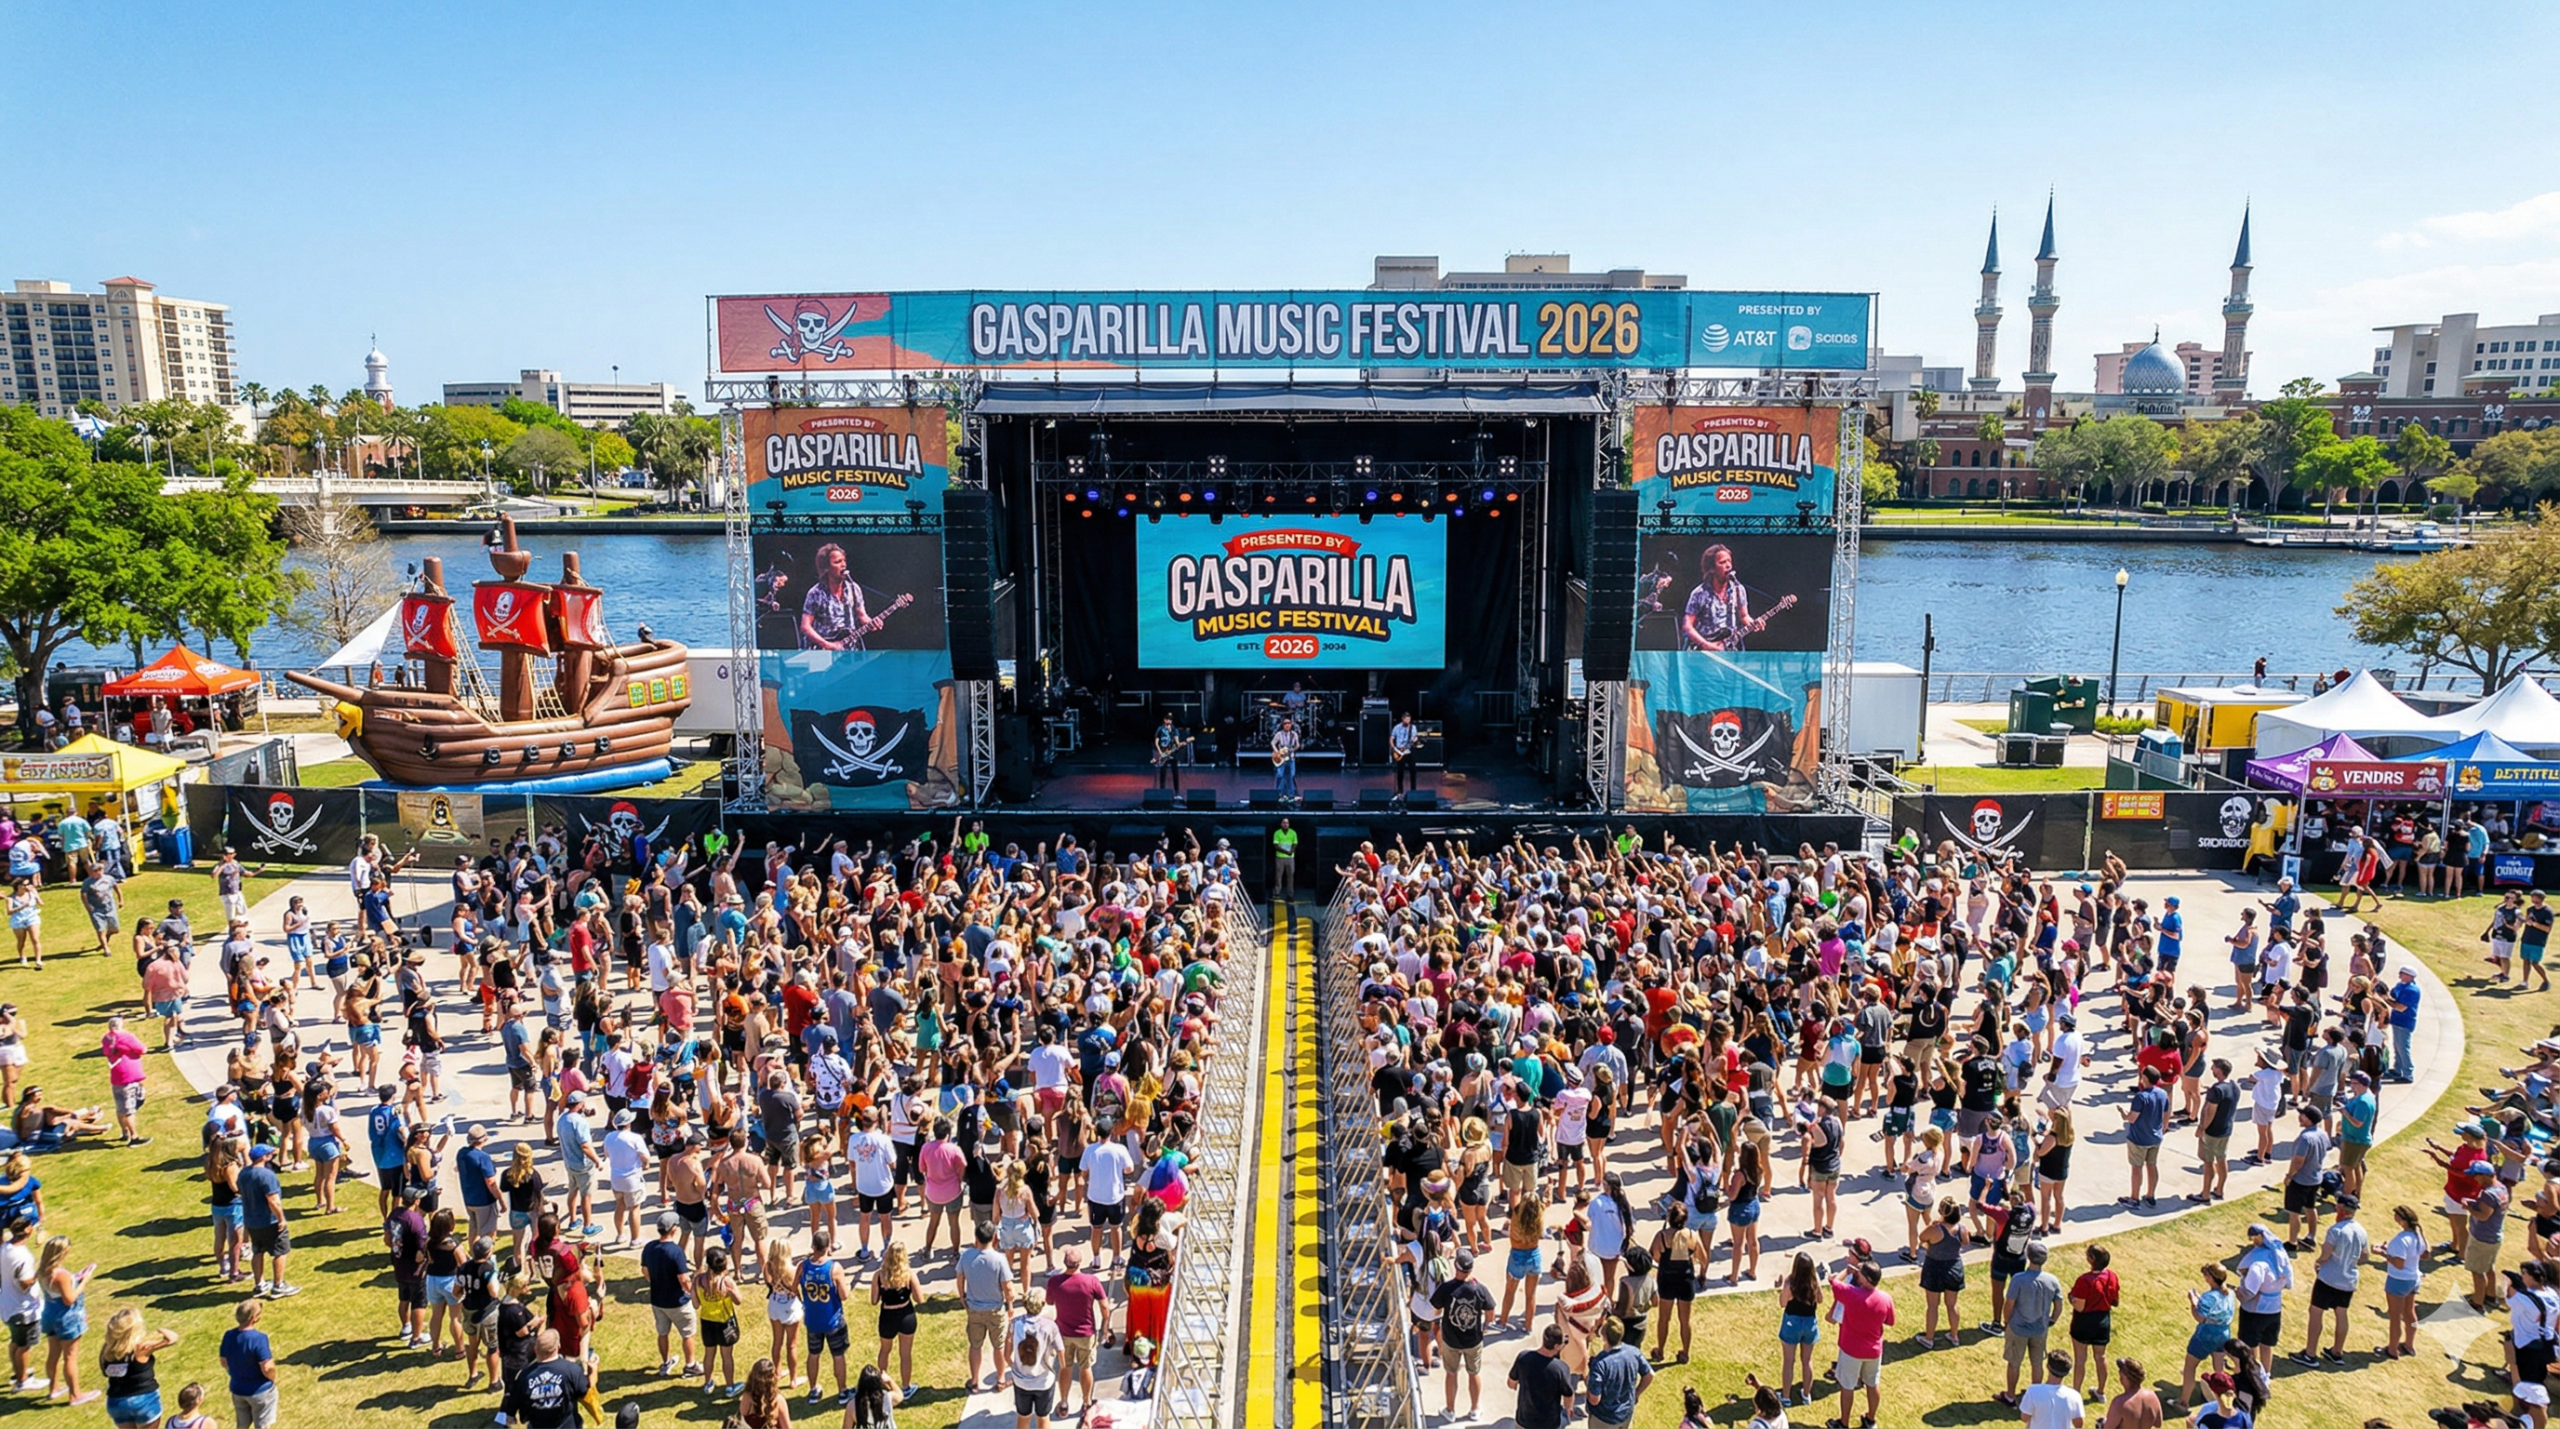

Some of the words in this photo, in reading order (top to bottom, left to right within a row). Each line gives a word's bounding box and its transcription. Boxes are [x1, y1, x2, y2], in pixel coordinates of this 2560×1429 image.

[1738, 305, 1804, 315] PRESENTED
[1806, 305, 1822, 316] BY
[971, 303, 1207, 355] GASPARILLA
[1217, 303, 1341, 355] MUSIC
[1351, 302, 1530, 354] FESTIVAL
[1538, 302, 1640, 354] 2026
[1733, 330, 1778, 346] AT&T
[766, 433, 922, 474] GASPARILLA
[1657, 433, 1813, 475] GASPARILLA
[783, 470, 832, 488] MUSIC
[836, 469, 907, 488] FESTIVAL
[1673, 470, 1722, 488] MUSIC
[1726, 469, 1797, 488] FESTIVAL
[829, 488, 860, 500] 2026
[1240, 533, 1323, 548] PRESENTED
[1325, 536, 1346, 549] BY
[1170, 556, 1413, 616] GASPARILLA
[1198, 611, 1272, 636] MUSIC
[1278, 610, 1387, 636] FESTIVAL
[1269, 639, 1315, 654] 2026
[2343, 770, 2404, 785] VENDRS
